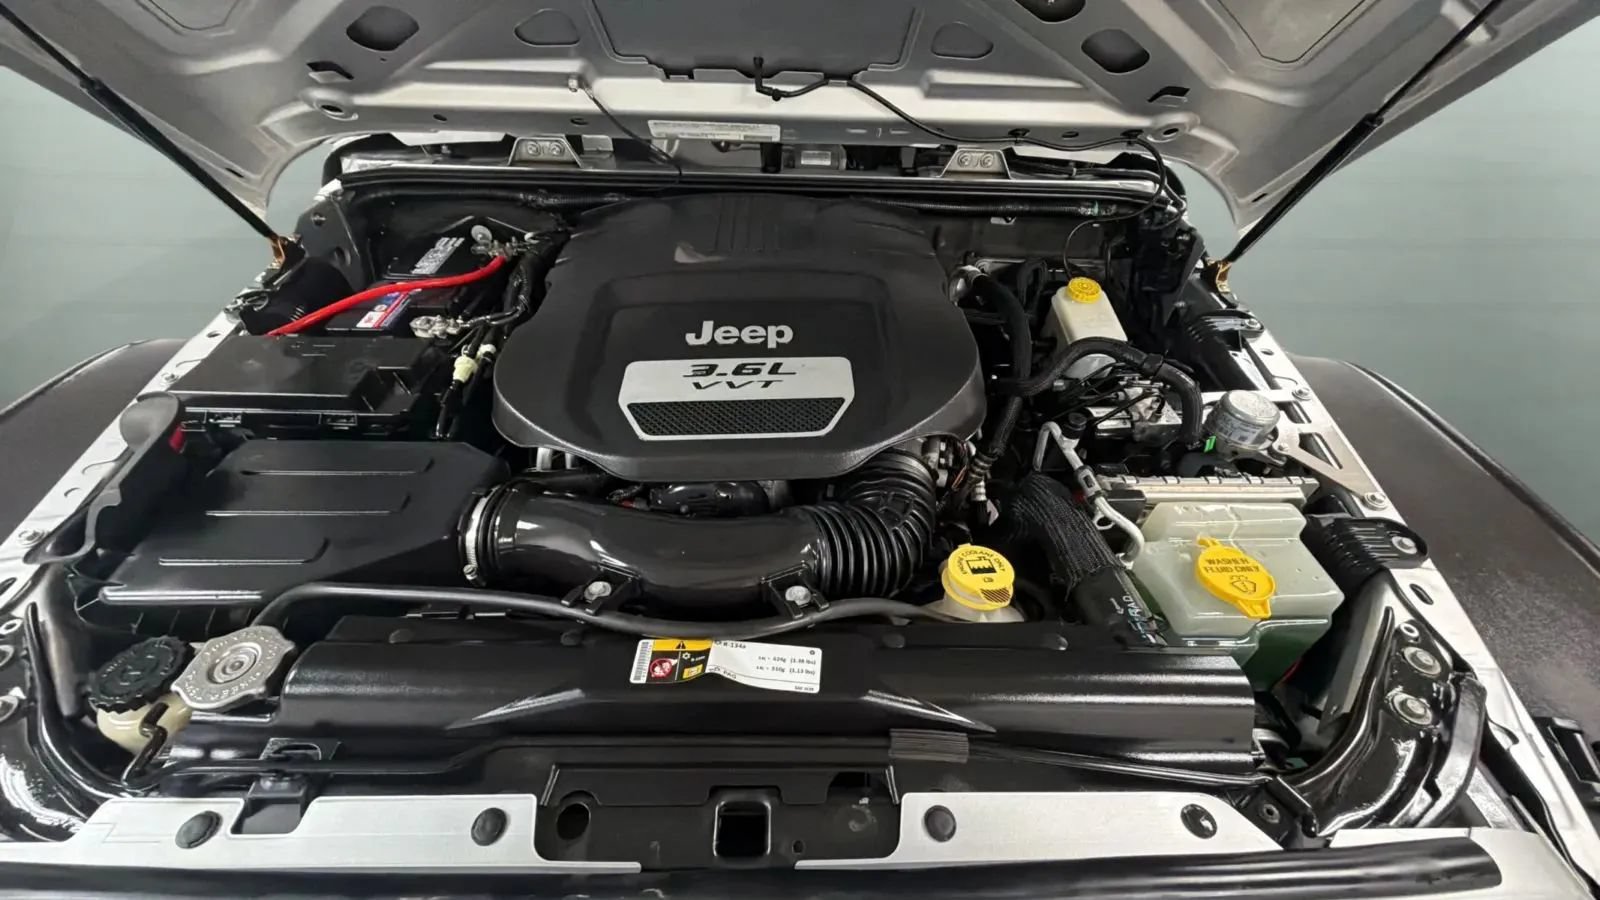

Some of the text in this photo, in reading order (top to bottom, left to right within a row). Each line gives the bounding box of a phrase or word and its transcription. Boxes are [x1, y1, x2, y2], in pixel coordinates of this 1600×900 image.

[685, 320, 794, 349] Jeep
[682, 362, 797, 378] 3.6L
[692, 379, 784, 390] VVT
[1234, 565, 1259, 573] ONLY
